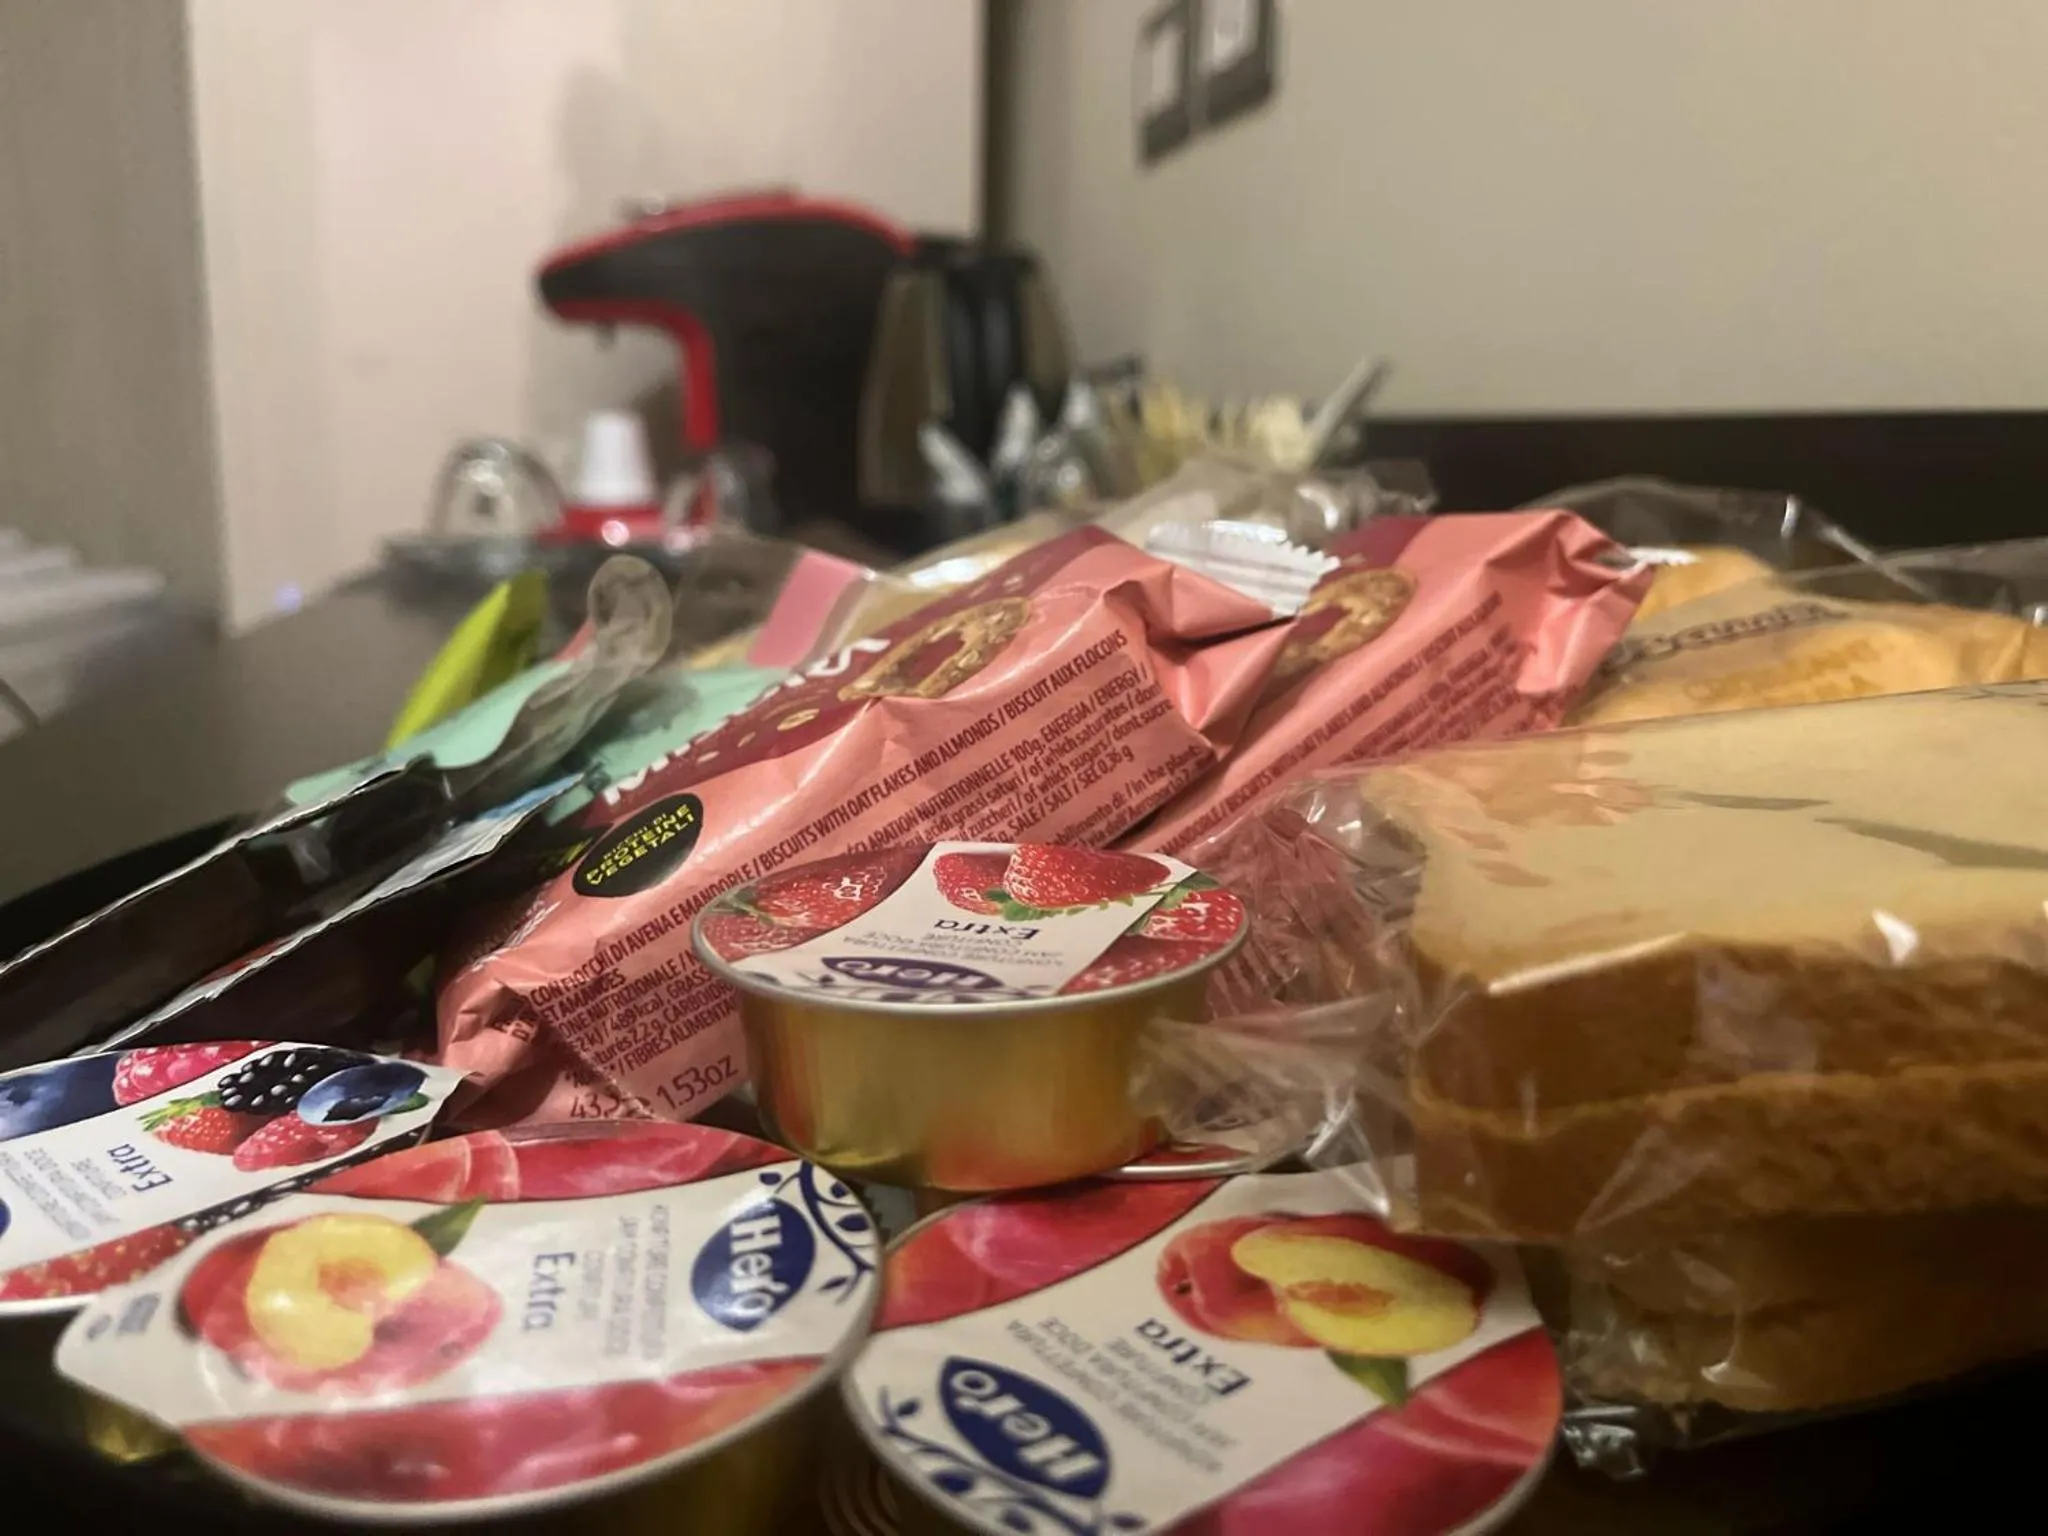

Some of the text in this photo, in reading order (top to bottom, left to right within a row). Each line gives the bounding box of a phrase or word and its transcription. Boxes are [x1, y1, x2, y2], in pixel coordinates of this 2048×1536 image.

[914, 751, 1013, 822] NUTRITIONNELLE
[1038, 699, 1092, 744] ENERGIA
[1092, 666, 1143, 707] ENERGY
[948, 791, 991, 828] grassi
[983, 769, 1023, 804] saturi
[1024, 754, 1045, 776] of
[1038, 734, 1079, 767] which
[1072, 699, 1129, 745] saturates
[964, 795, 1017, 838] zuccheri
[1019, 781, 1040, 804] of
[1033, 759, 1073, 794] which
[1067, 736, 1110, 774] sugars
[1107, 710, 1142, 742] dont
[528, 978, 562, 1009] CON
[608, 939, 630, 962] DI
[623, 911, 675, 953] AVENA
[669, 906, 683, 924] E
[758, 824, 818, 869] BISCUITS
[813, 804, 852, 836] WITH
[845, 790, 874, 817] OAT
[867, 764, 917, 803] FLAKES
[912, 749, 942, 776] AND
[936, 712, 1000, 762] ALMONDS
[1002, 677, 1054, 719] BISCUIT
[1049, 662, 1079, 689] AUX
[1071, 628, 1128, 674] FLOCONS
[1008, 805, 1042, 837] SALE
[1042, 784, 1075, 813] SALT
[1076, 765, 1103, 789] SEL
[1120, 744, 1136, 763] g
[584, 803, 690, 881] PROTEINE
[588, 813, 694, 887] VEGETALI
[935, 918, 1040, 941] Extra
[556, 967, 626, 1017] AMANDES
[586, 957, 681, 1023] NUTRIZIONALE
[606, 1005, 639, 1034] 489
[665, 962, 714, 1000] GRASS
[836, 957, 989, 988] Hero
[622, 1031, 673, 1071] FIBRES
[108, 1142, 173, 1194] Extra
[521, 1250, 577, 1333] Extra
[729, 1214, 791, 1320] Hero
[1134, 1317, 1253, 1397] Extra
[950, 1367, 1105, 1482] Hero
